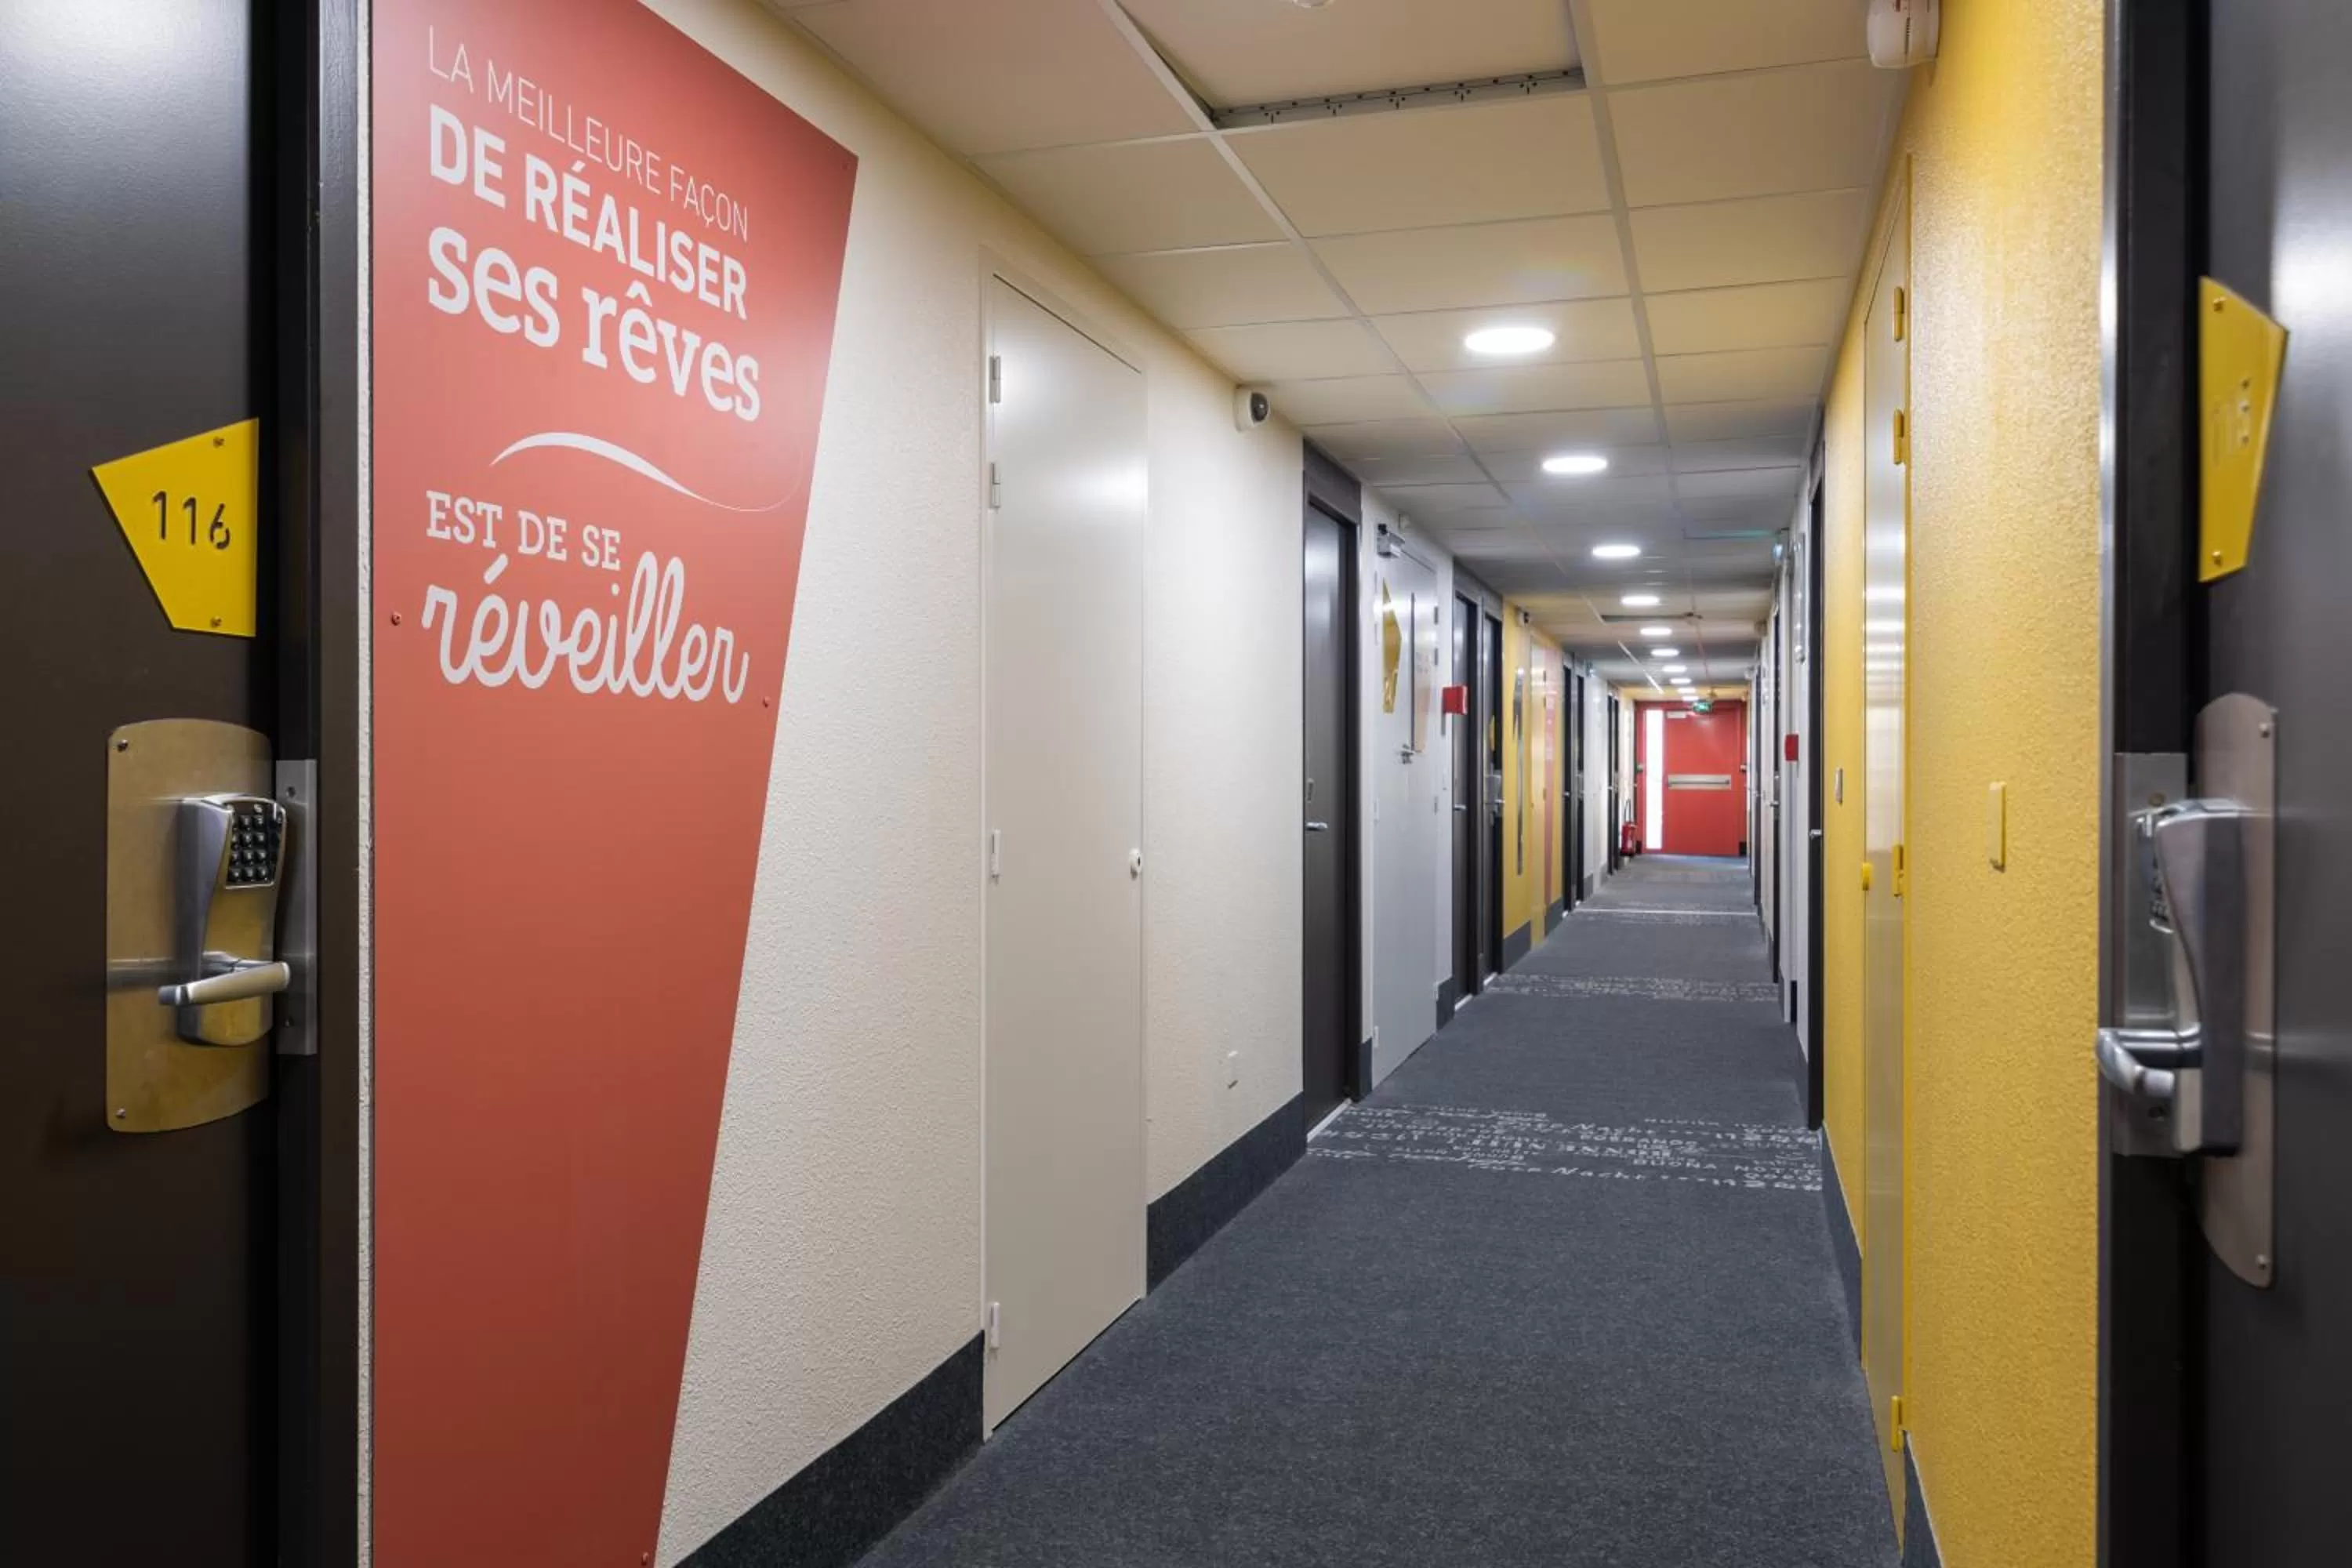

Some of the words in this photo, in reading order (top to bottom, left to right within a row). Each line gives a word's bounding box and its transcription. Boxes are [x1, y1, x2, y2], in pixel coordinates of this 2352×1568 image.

[429, 25, 474, 93] LA
[488, 59, 661, 195] MEILLEURE
[670, 164, 748, 243] FAÇON
[430, 103, 506, 209] DE
[524, 159, 747, 321] RÉALISER
[427, 226, 561, 348] ses
[581, 279, 760, 422] rêves
[151, 490, 231, 550] 116
[426, 489, 503, 550] EST
[517, 509, 568, 562] DE
[580, 524, 621, 572] SE
[420, 550, 750, 705] réveiller
